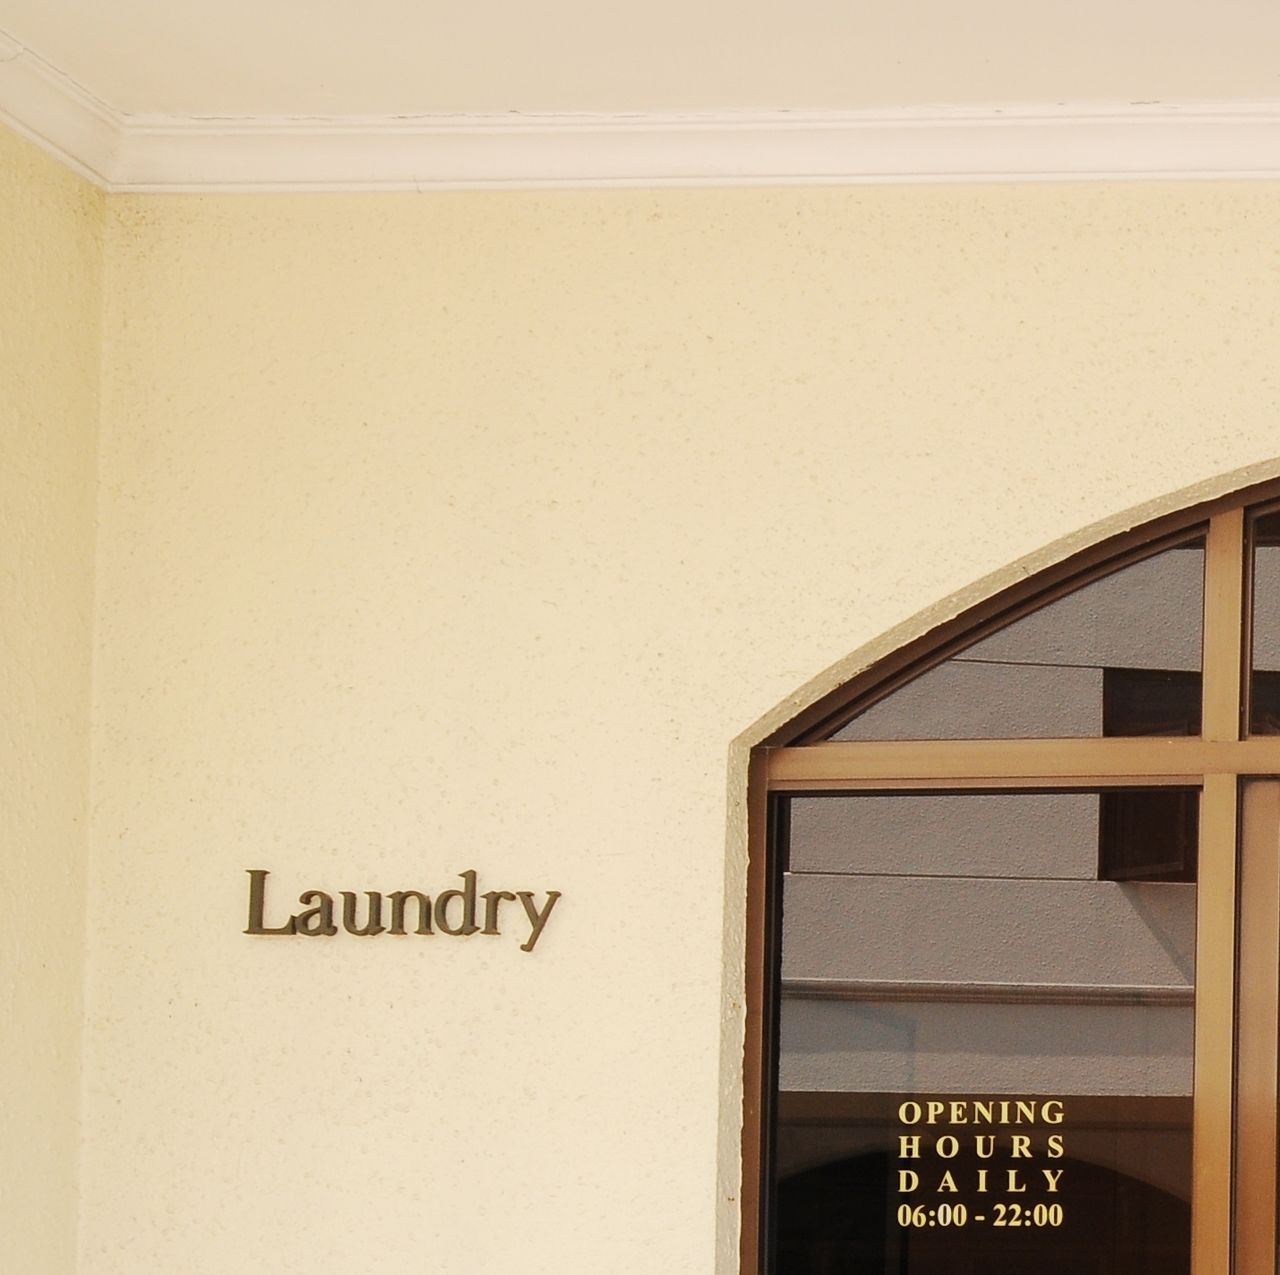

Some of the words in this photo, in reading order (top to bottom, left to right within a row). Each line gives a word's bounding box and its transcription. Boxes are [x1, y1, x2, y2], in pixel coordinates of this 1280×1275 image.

[243, 869, 562, 952] Laundry
[898, 1101, 1065, 1125] OPENING
[898, 1135, 1064, 1158] HOURS
[898, 1170, 1064, 1192] DAILY
[897, 1203, 967, 1227] 06:00
[993, 1203, 1064, 1227] 22:00
